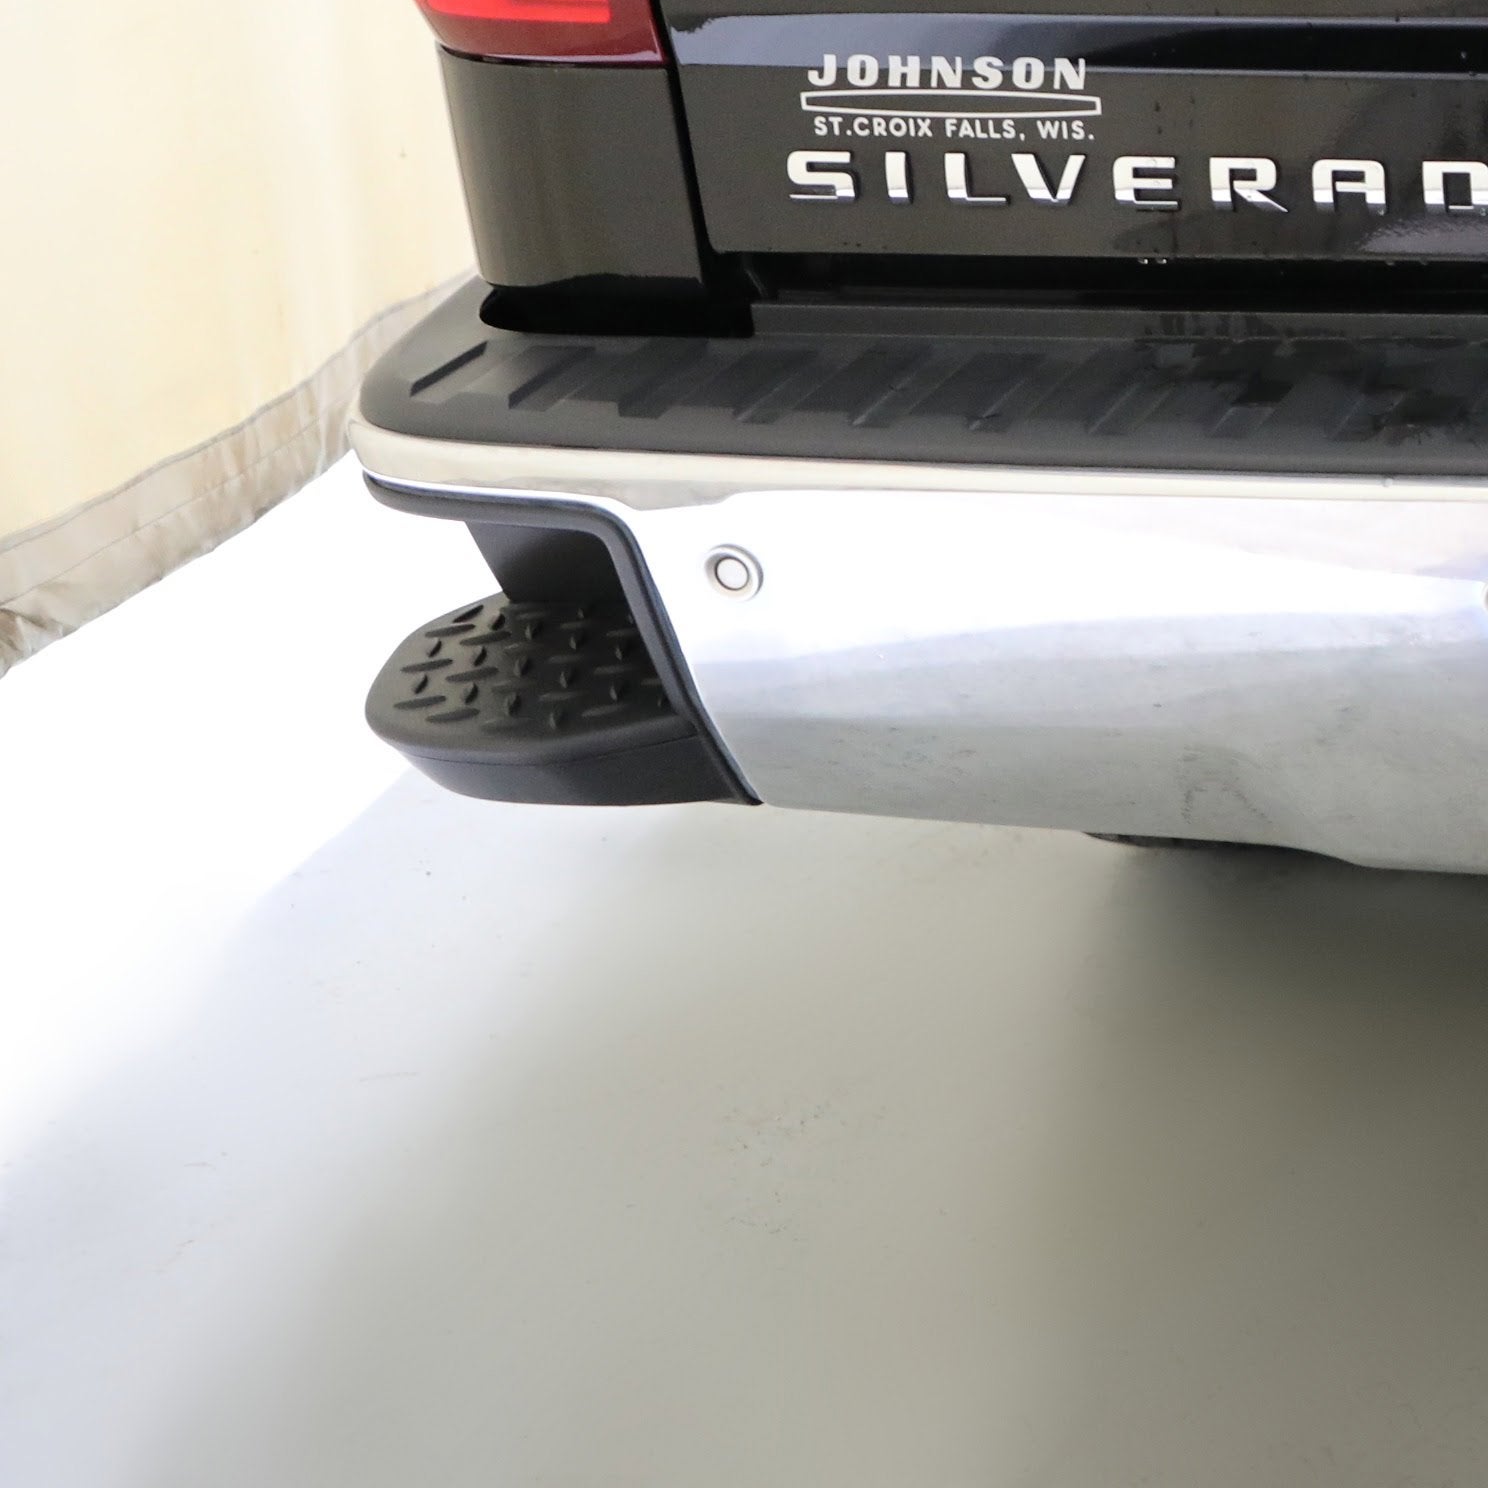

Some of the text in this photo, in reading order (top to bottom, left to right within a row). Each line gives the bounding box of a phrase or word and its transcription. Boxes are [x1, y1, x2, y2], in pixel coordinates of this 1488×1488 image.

[807, 54, 1087, 90] JOHNSON
[945, 117, 1026, 141] FALLS,
[1036, 120, 1095, 140] WIS.
